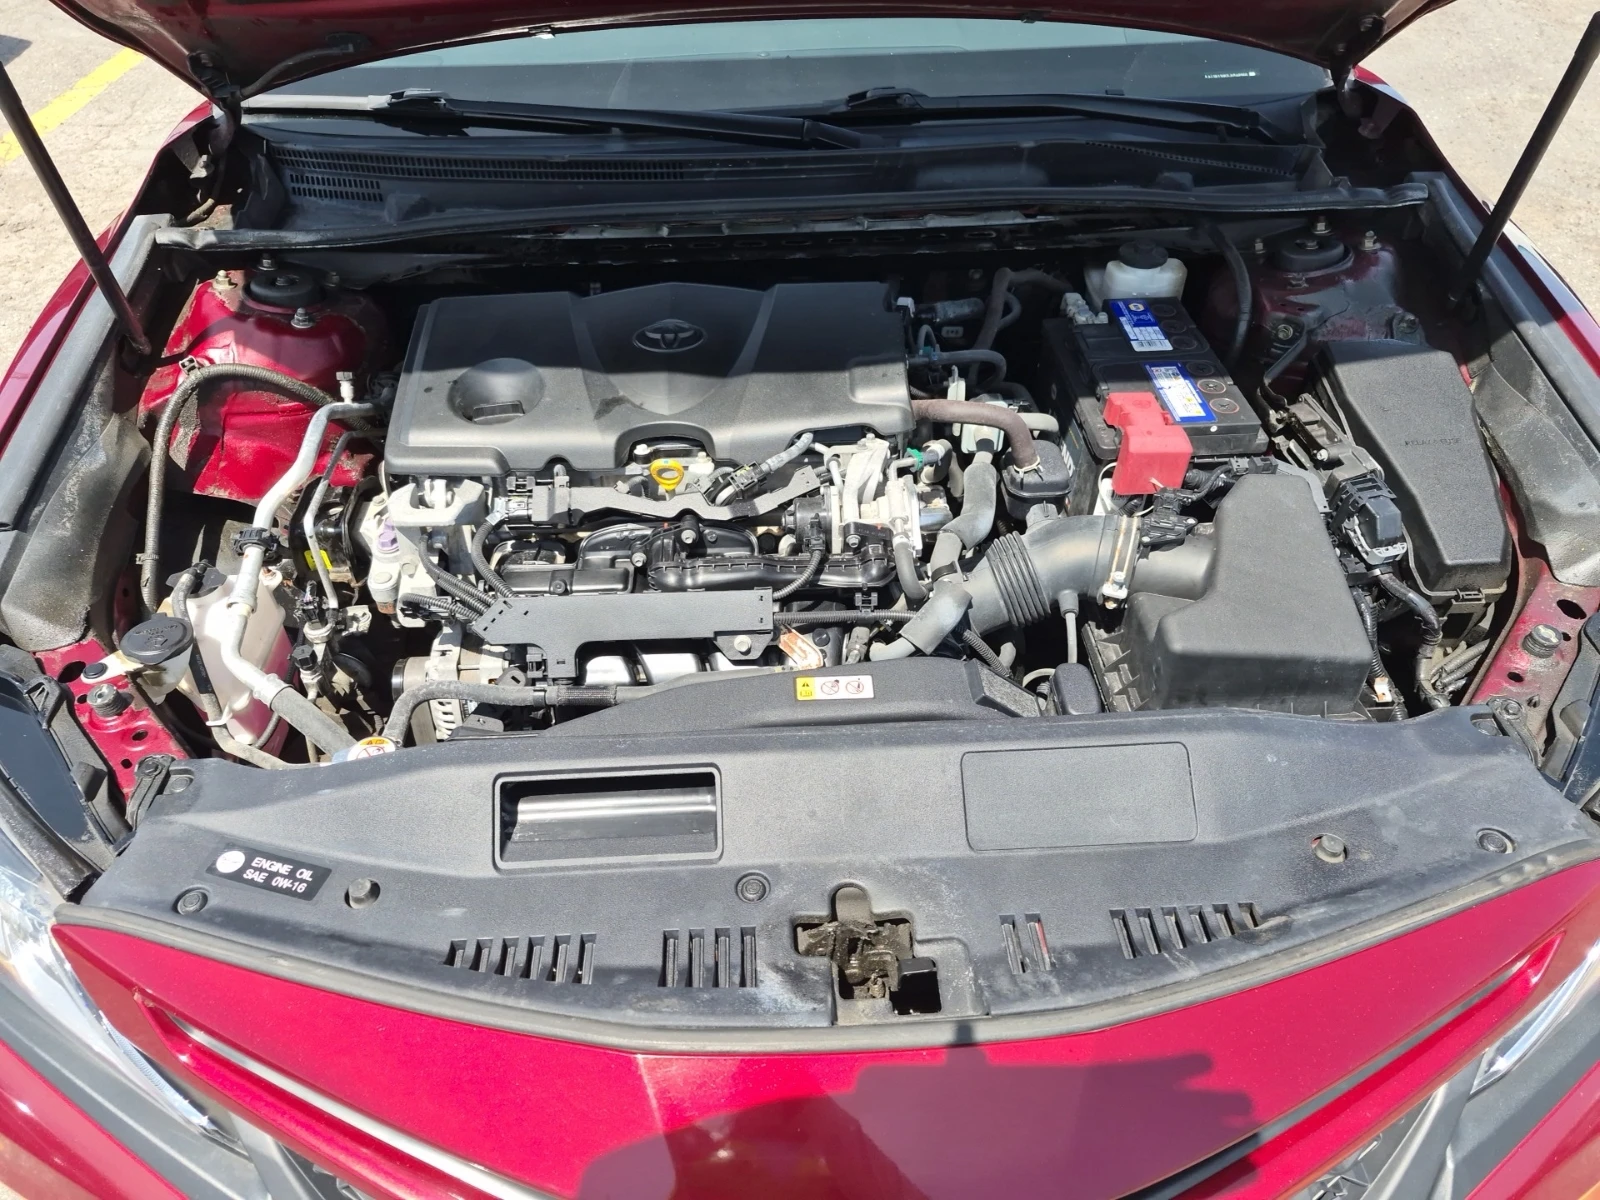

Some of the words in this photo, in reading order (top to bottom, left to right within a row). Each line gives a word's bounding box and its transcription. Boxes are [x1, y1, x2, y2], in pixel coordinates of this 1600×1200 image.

[243, 869, 268, 882] SAE
[271, 876, 307, 893] 0W-16
[251, 857, 293, 875] ENGINE
[296, 868, 313, 881] OIL
